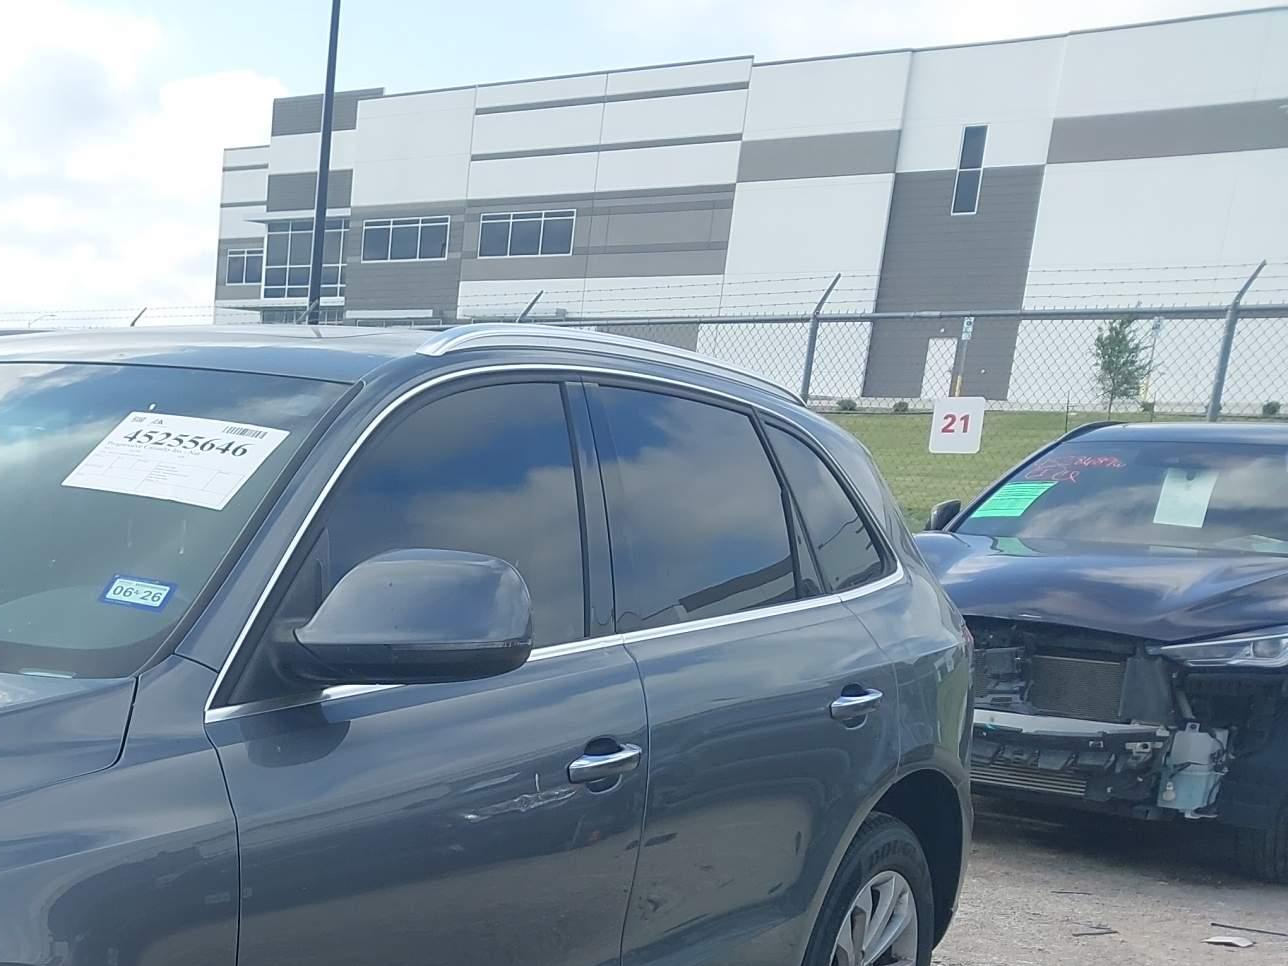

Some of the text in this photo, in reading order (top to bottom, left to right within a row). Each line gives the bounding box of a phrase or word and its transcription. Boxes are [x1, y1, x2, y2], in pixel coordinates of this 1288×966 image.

[941, 414, 970, 433] 21
[123, 428, 252, 457] 45255646
[112, 584, 133, 598] 06
[139, 590, 162, 603] 26
